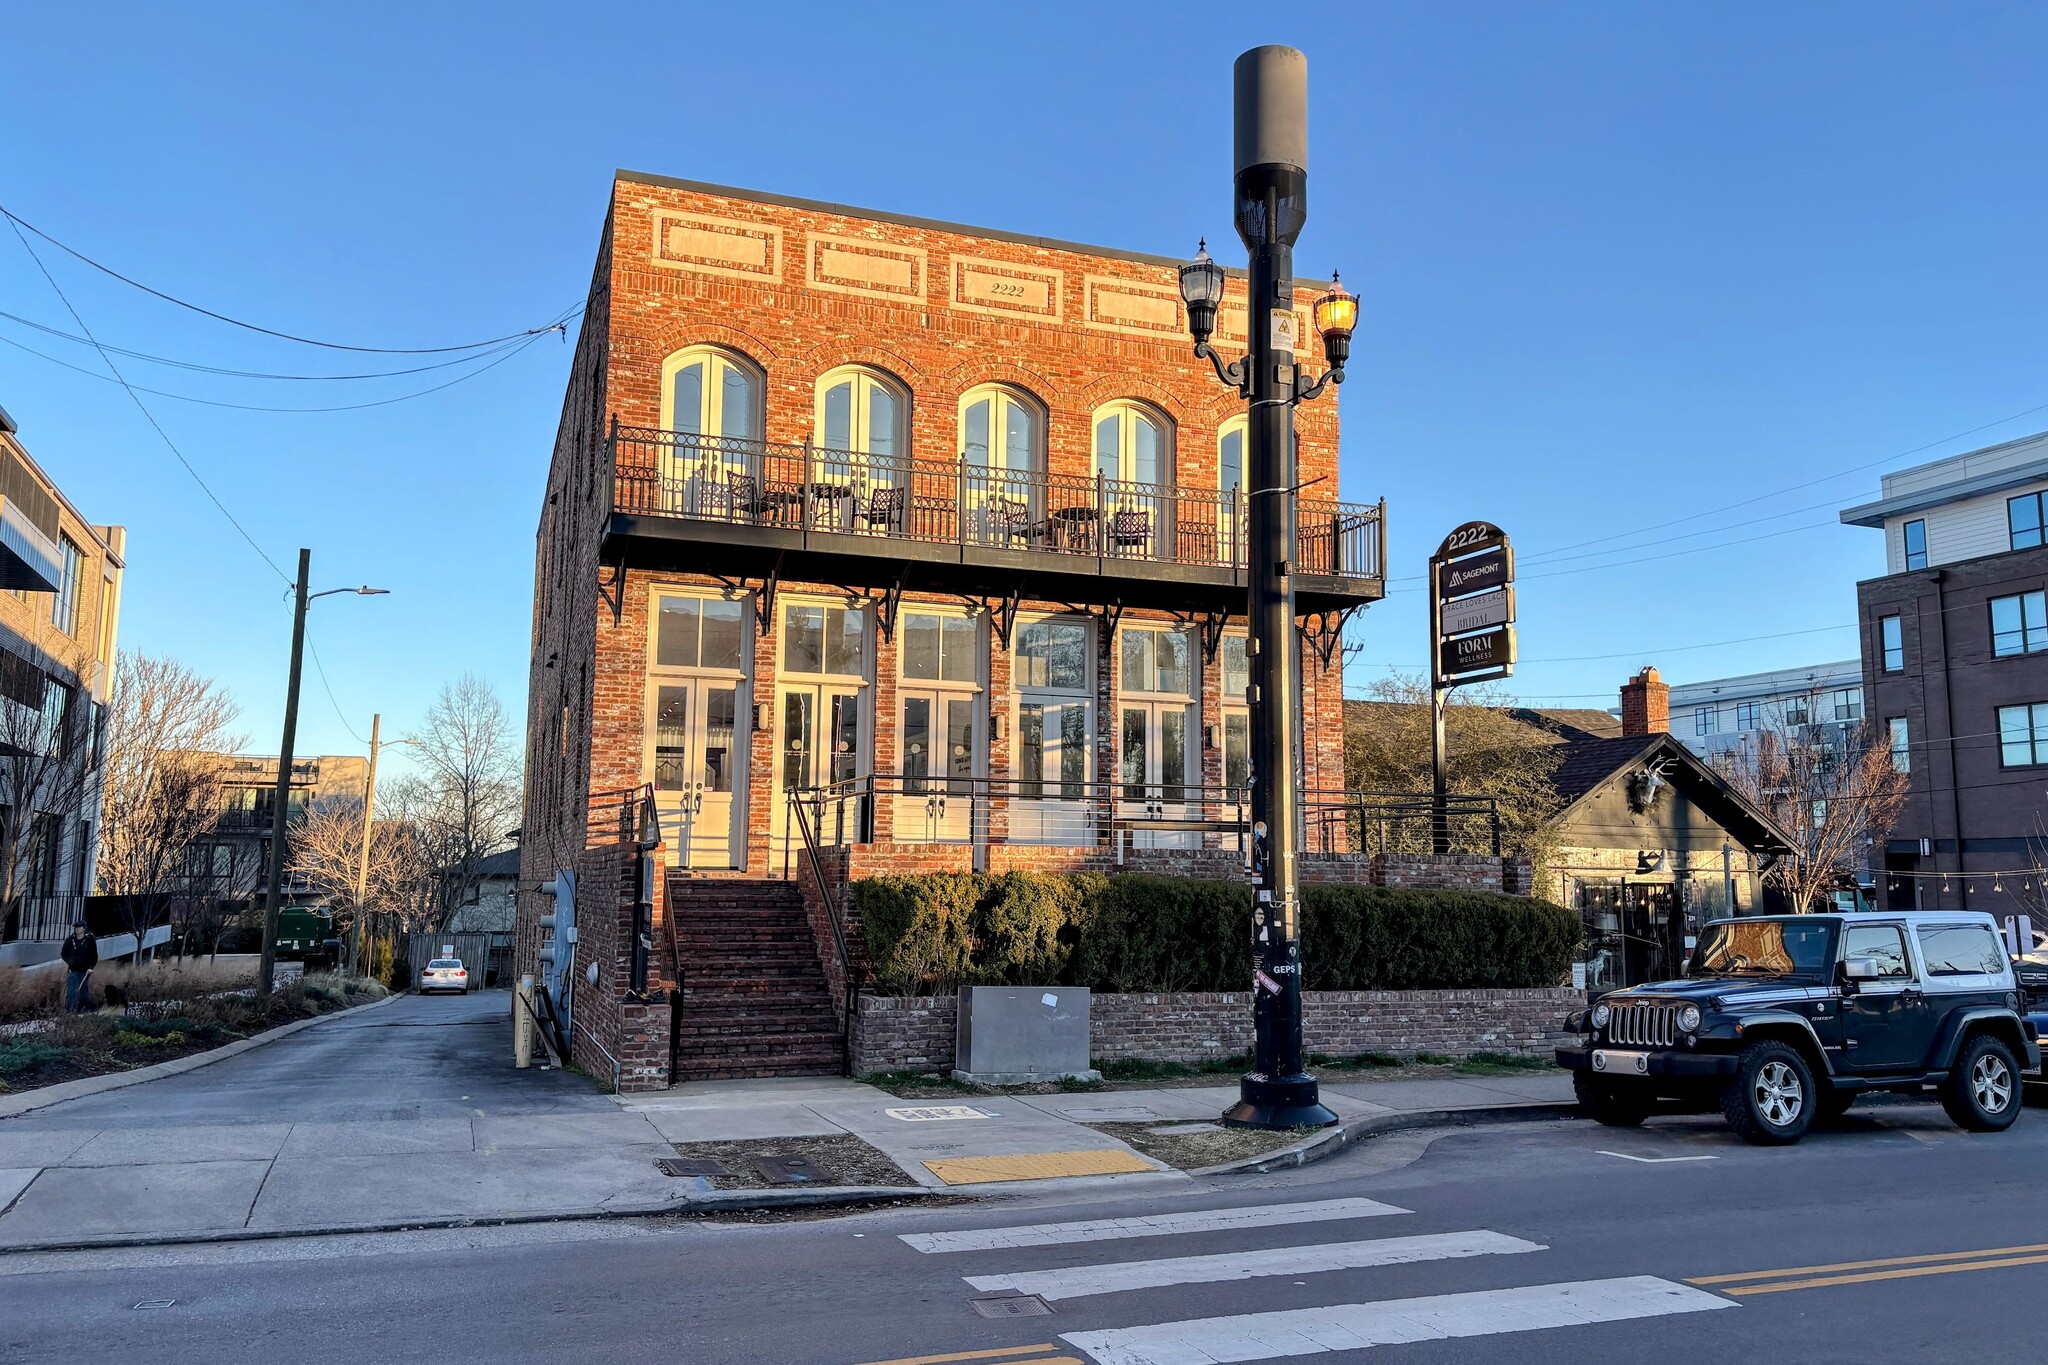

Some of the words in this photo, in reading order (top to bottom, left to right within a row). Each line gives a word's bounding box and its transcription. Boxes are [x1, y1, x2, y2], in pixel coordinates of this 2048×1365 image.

[990, 282, 1025, 298] 2222
[1448, 524, 1489, 551] 2222
[1462, 562, 1500, 580] SAGEMONT
[1443, 602, 1464, 613] GRACE
[1465, 596, 1486, 608] LOVES
[1488, 591, 1505, 603] LACE
[1457, 613, 1491, 630] BRIDAL
[1458, 635, 1492, 655] FORM
[1459, 651, 1492, 664] WELLNESS
